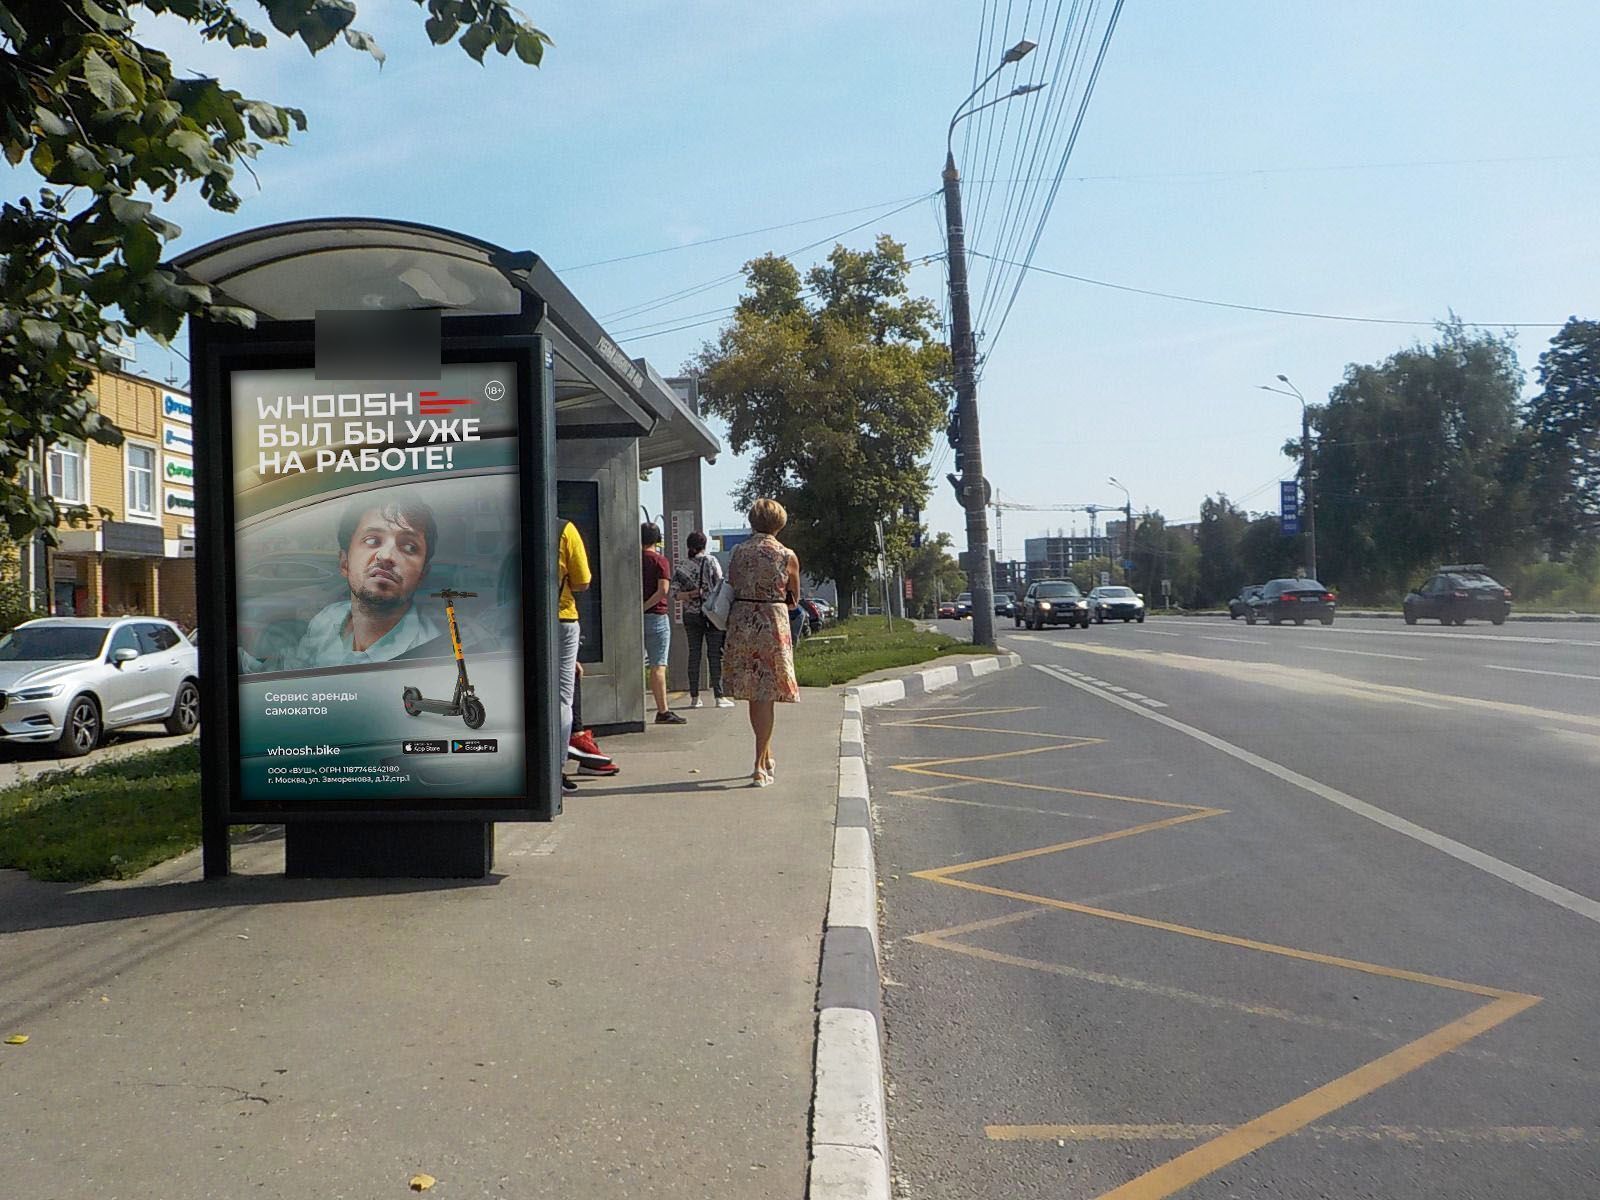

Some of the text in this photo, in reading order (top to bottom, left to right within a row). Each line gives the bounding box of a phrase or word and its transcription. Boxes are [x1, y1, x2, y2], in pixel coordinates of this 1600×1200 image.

[487, 386, 503, 396] 18+
[256, 392, 413, 420] WHOOSH
[258, 418, 481, 448] БЫЛ БЫ УЖЕ
[259, 446, 454, 475] НА РАБОТЕ!
[264, 692, 358, 703] Сервис аренды
[265, 706, 328, 716] самокатов
[267, 744, 340, 756] whoosh.bike
[267, 767, 288, 775] ООО
[318, 766, 341, 774] ОГРН
[275, 776, 308, 785] Москва,
[308, 777, 321, 785] ул.
